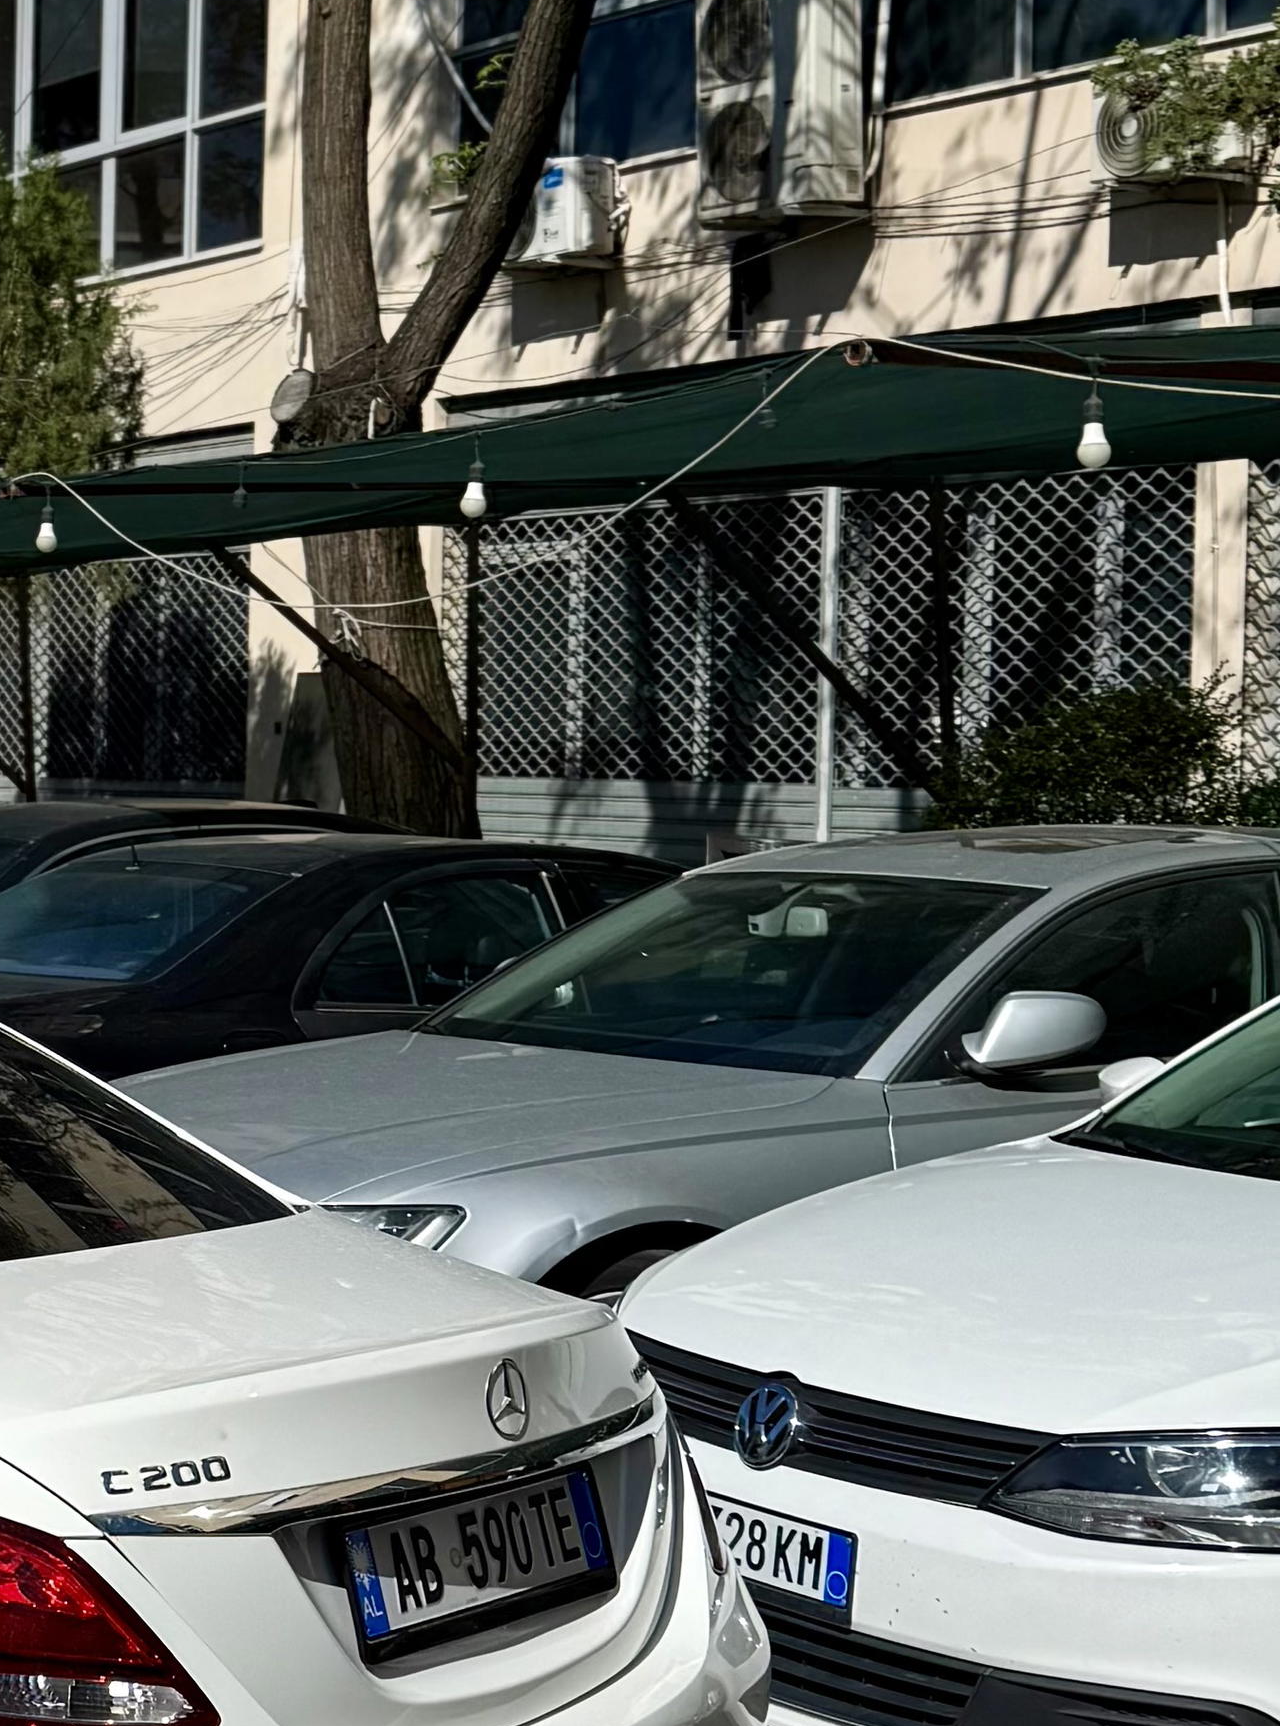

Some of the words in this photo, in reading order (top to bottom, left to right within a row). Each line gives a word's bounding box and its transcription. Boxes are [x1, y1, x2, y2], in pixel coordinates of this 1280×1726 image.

[101, 1470, 133, 1495] C
[139, 1455, 231, 1491] 200
[390, 1525, 444, 1614] AB
[457, 1501, 533, 1589] 590
[528, 1486, 581, 1568] TE
[772, 1525, 824, 1591] KM
[363, 1596, 383, 1618] AL
